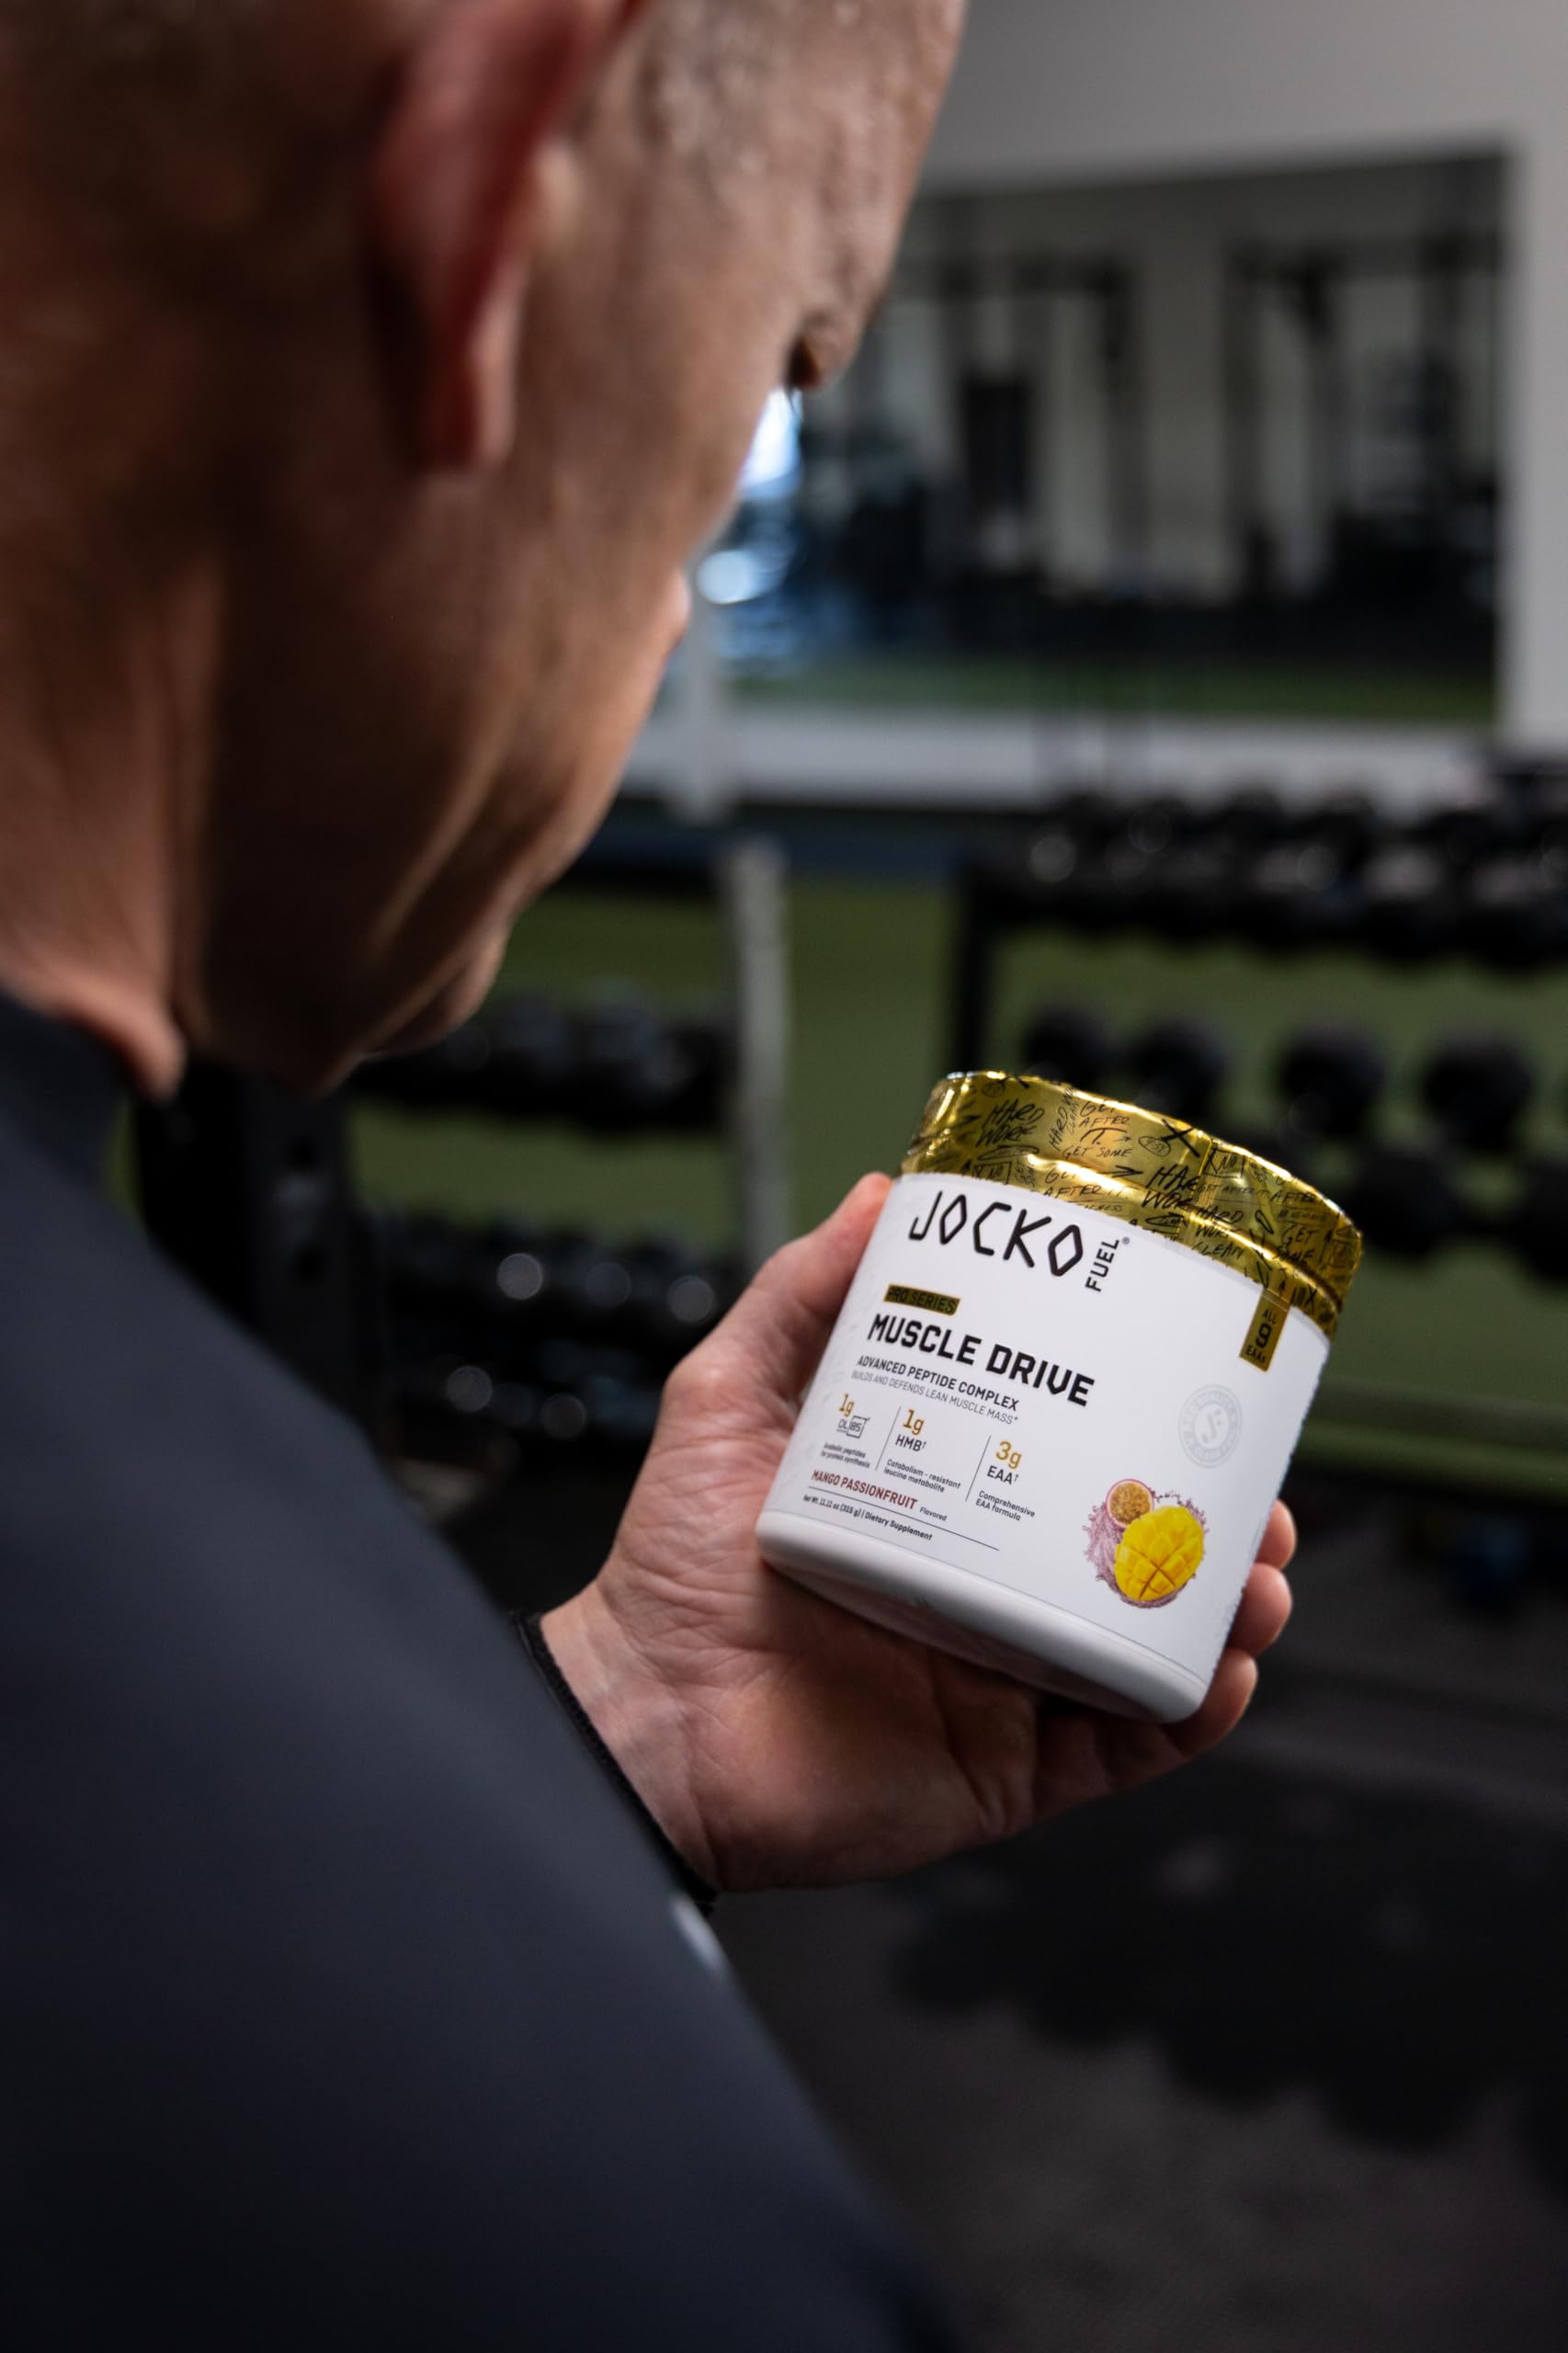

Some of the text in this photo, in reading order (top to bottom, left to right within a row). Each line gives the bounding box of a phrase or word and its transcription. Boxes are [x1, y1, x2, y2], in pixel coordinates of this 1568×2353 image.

[982, 1098, 1044, 1128] HARD
[1079, 1116, 1131, 1128] AFTER
[1062, 1146, 1133, 1159] GET SOME
[1043, 1185, 1102, 1199] AFTER
[908, 1190, 1084, 1277] JOCKO
[911, 1291, 957, 1313] SERIES
[1263, 1309, 1278, 1324] ALL
[1256, 1323, 1272, 1349] 9
[867, 1313, 1096, 1407] MUSCLE DRIVE
[858, 1355, 1020, 1412] ADVANCED PEPTIDE COMPLEX
[873, 1375, 889, 1386] AND
[889, 1378, 925, 1395] DEFENDS
[925, 1388, 949, 1403] LEAN
[949, 1395, 986, 1415] MUSCLE
[903, 1409, 925, 1435] 1g
[995, 1440, 1023, 1469] 3g
[883, 1468, 945, 1493] leucine metabolite
[886, 1459, 924, 1476] Catabolism
[928, 1472, 961, 1489] resistant
[811, 1470, 948, 1521] MANGO PASSIONFRUIT Flavored
[975, 1498, 1021, 1521] EAA formula
[978, 1490, 1036, 1518] Comprehensive
[864, 1511, 890, 1527] Dietary
[889, 1519, 932, 1540] Supplement
